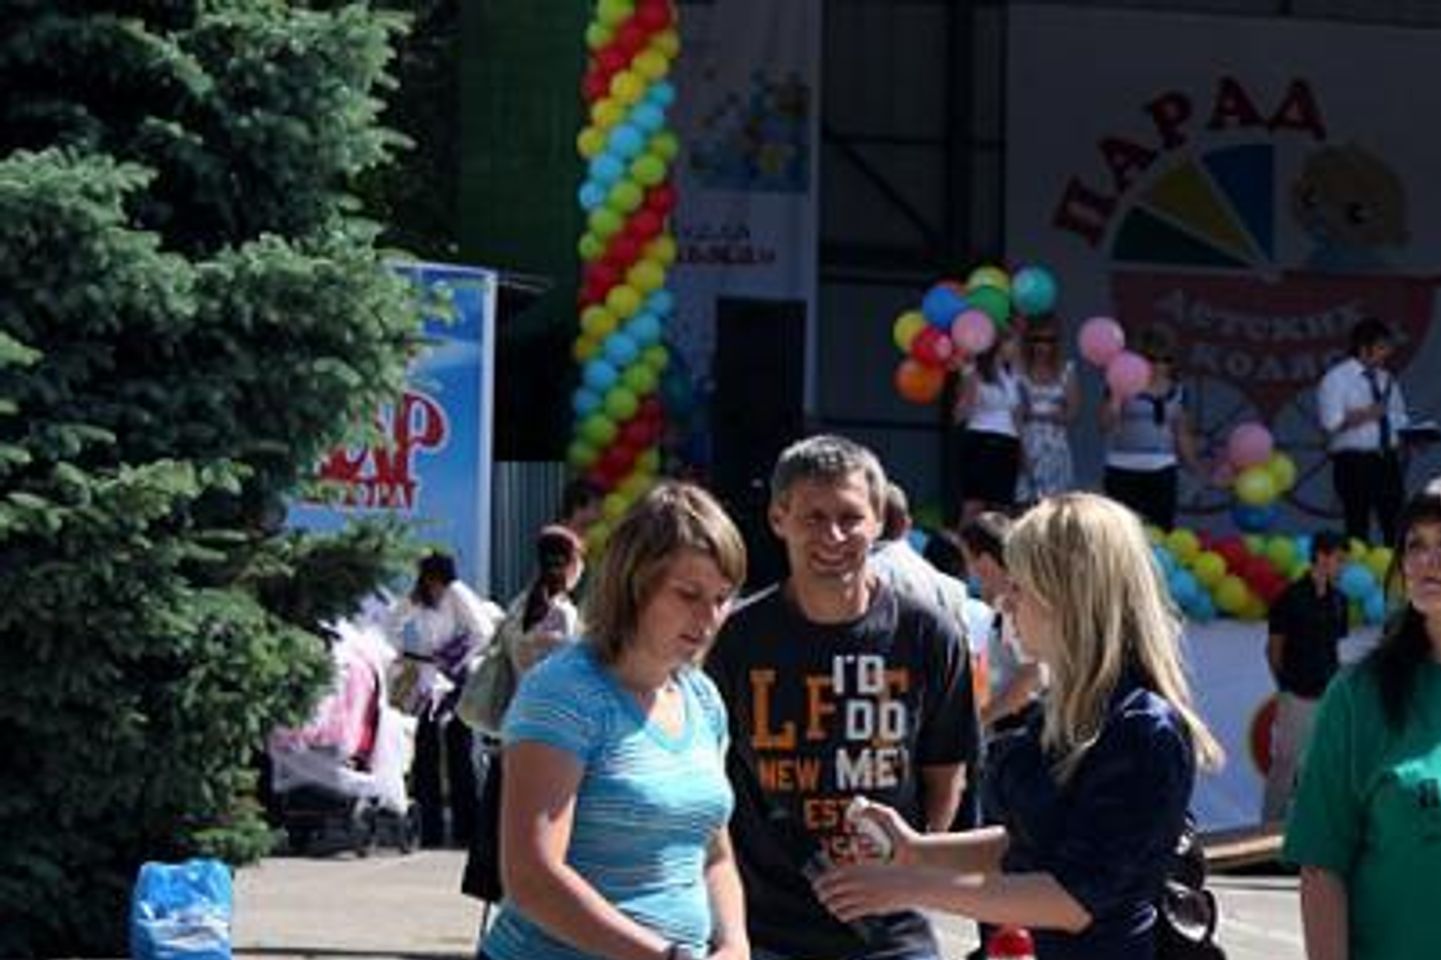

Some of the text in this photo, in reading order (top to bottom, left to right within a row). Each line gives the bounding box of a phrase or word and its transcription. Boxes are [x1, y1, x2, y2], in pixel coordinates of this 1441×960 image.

[1051, 75, 1327, 248] ПАРАД
[844, 699, 908, 743] DO
[758, 754, 821, 793] NEW
